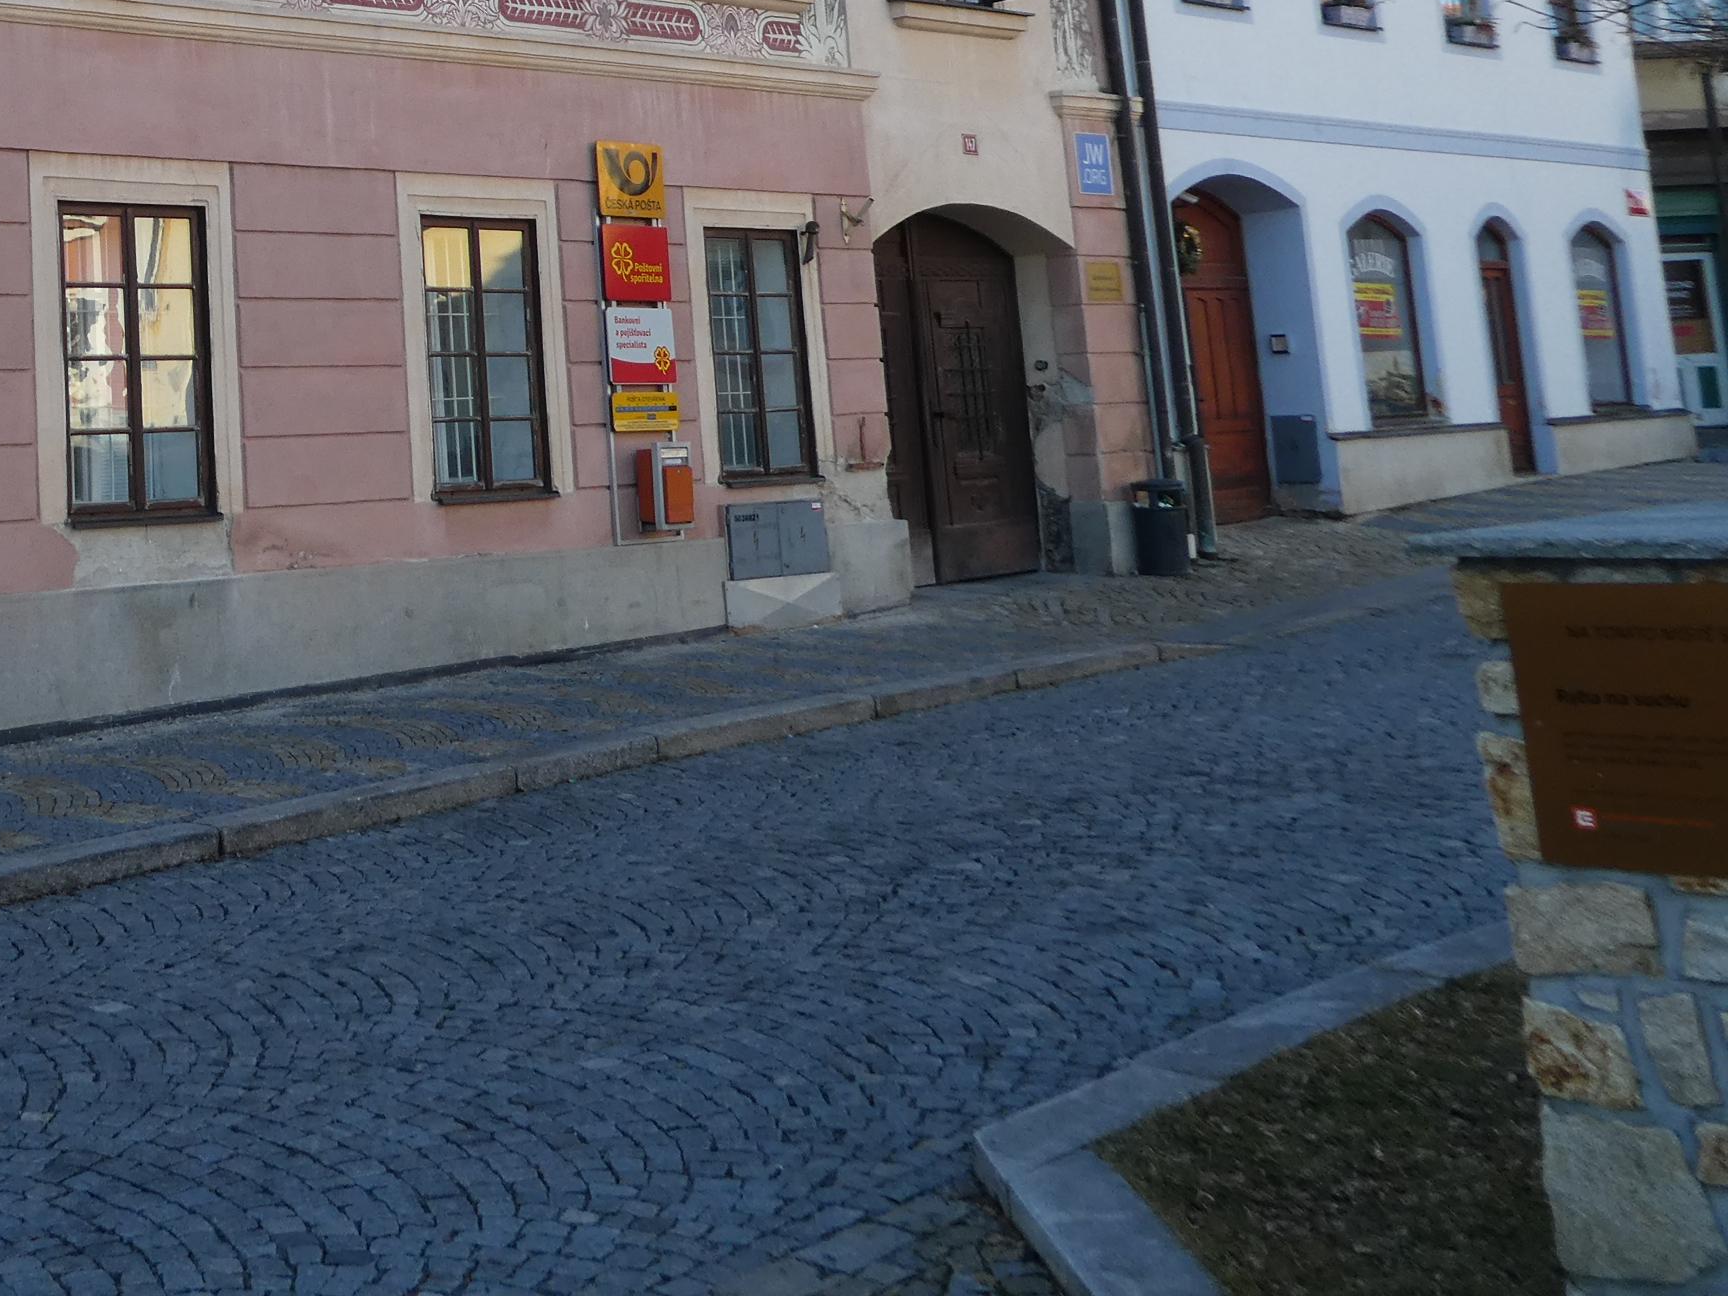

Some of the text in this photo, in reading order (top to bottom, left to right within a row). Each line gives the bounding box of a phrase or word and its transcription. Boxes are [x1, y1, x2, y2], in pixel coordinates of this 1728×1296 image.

[1082, 142, 1104, 165] JW
[605, 196, 662, 211] ČESKÁ POŠTA
